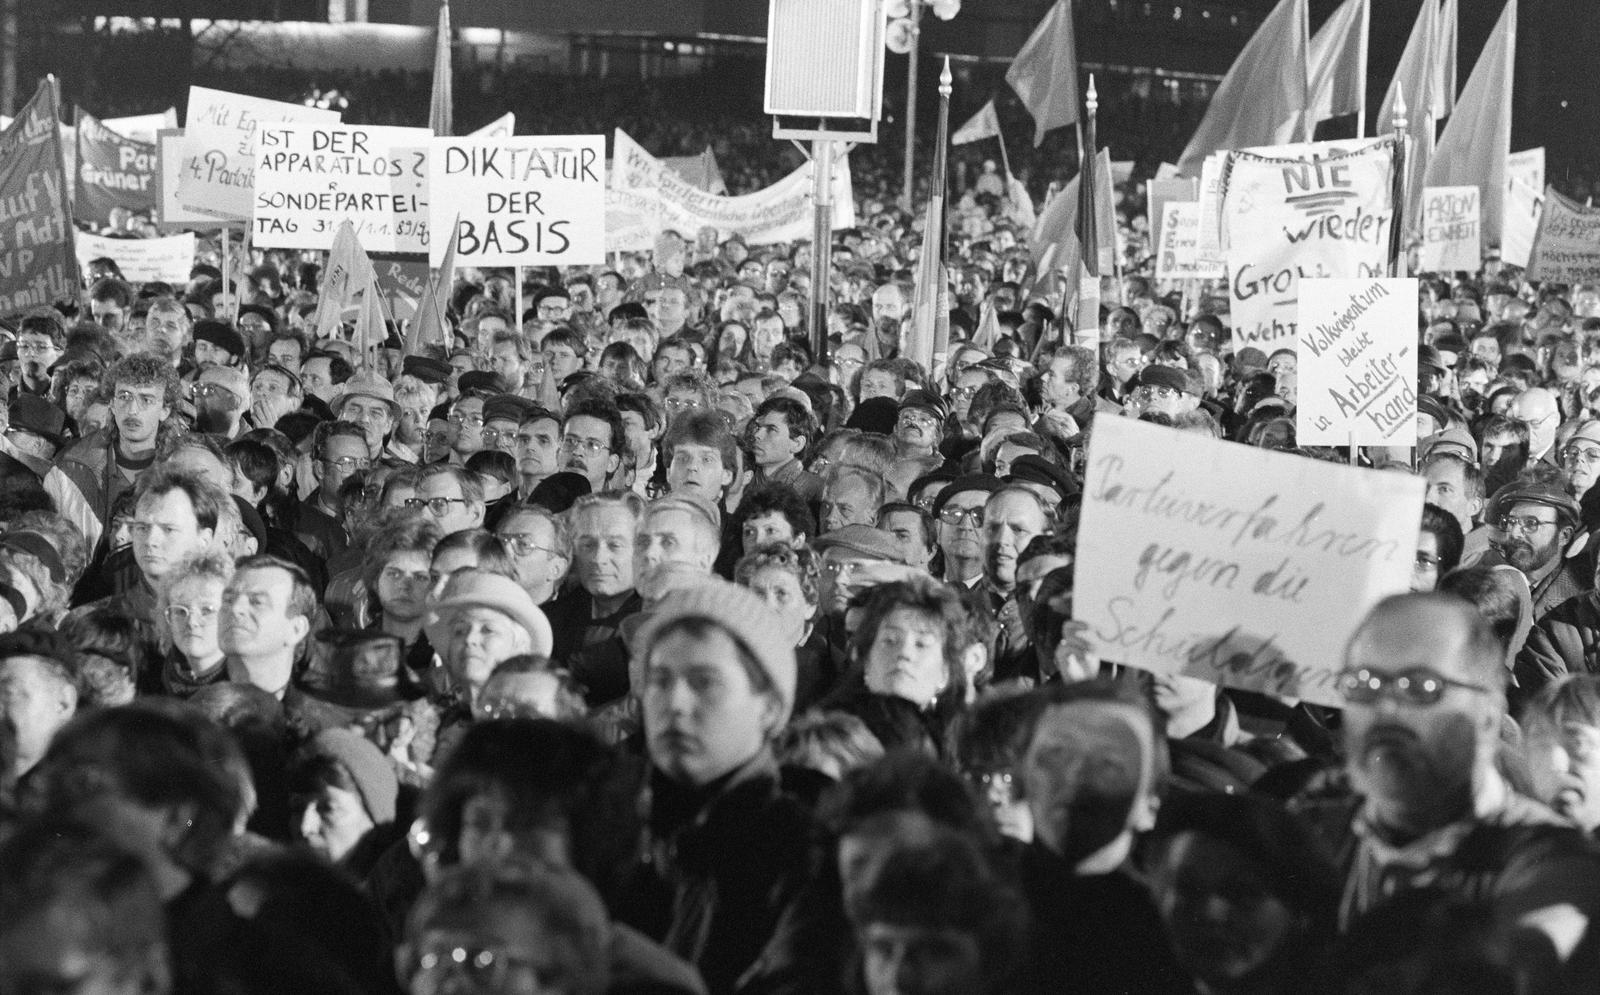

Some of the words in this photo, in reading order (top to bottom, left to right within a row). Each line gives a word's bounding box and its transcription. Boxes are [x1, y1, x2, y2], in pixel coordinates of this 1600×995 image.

[237, 110, 257, 140] Eg
[261, 129, 295, 149] IST
[312, 129, 369, 154] DER
[445, 146, 599, 182] DIKTATUR
[1282, 153, 1353, 194] NIE
[487, 190, 545, 215] DER
[256, 217, 298, 234] TAG
[457, 219, 571, 256] BASIS
[1282, 206, 1390, 245] wieder
[1301, 282, 1390, 358] Volkseigentum
[1337, 332, 1374, 368] bleibt
[1366, 375, 1418, 432] hand
[1308, 414, 1333, 432] in
[1134, 542, 1241, 601] gegen
[1253, 558, 1309, 603] die
